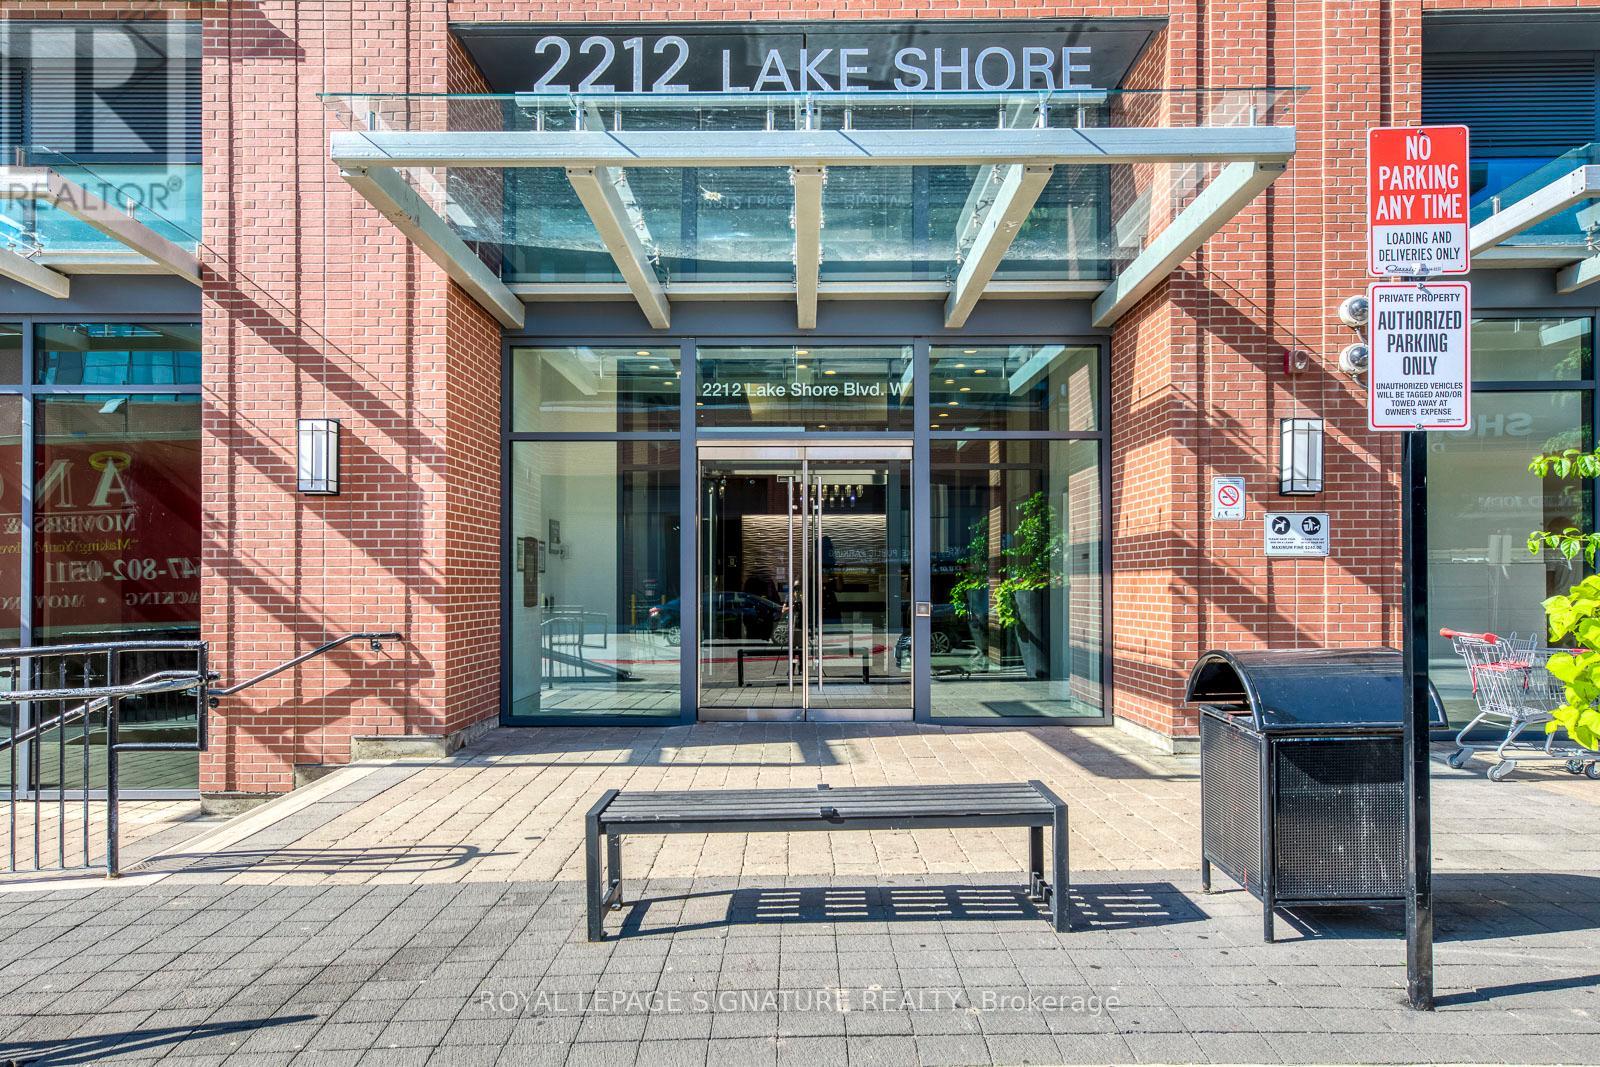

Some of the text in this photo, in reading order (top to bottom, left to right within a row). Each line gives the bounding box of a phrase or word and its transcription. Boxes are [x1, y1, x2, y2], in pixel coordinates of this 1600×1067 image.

[533, 36, 1093, 92] 2212 LAKE SHORE
[1405, 135, 1432, 161] NO
[1378, 164, 1459, 191] PARKING
[1375, 193, 1463, 220] ANY TIME
[1386, 231, 1452, 245] LOADING AND
[1378, 247, 1460, 262] DELIVERIES ONLY
[1379, 293, 1461, 303] PRIVATE PROPERTY
[1378, 310, 1462, 331] AUTHORIZED
[1387, 333, 1448, 353] PARKING
[1402, 356, 1438, 376] ONLY
[702, 382, 742, 397] 2212
[747, 382, 786, 397] Lake
[790, 382, 839, 397] Shore
[843, 382, 885, 397] Blvd.
[1376, 382, 1463, 390] UNAUTHORIZED VEHICLES
[1376, 390, 1462, 399] WILL BE TAGGED AND/OR
[1391, 400, 1416, 408] TOWED
[1417, 400, 1437, 408] AWAY
[1385, 408, 1452, 416] OWNER'S EXPENSE
